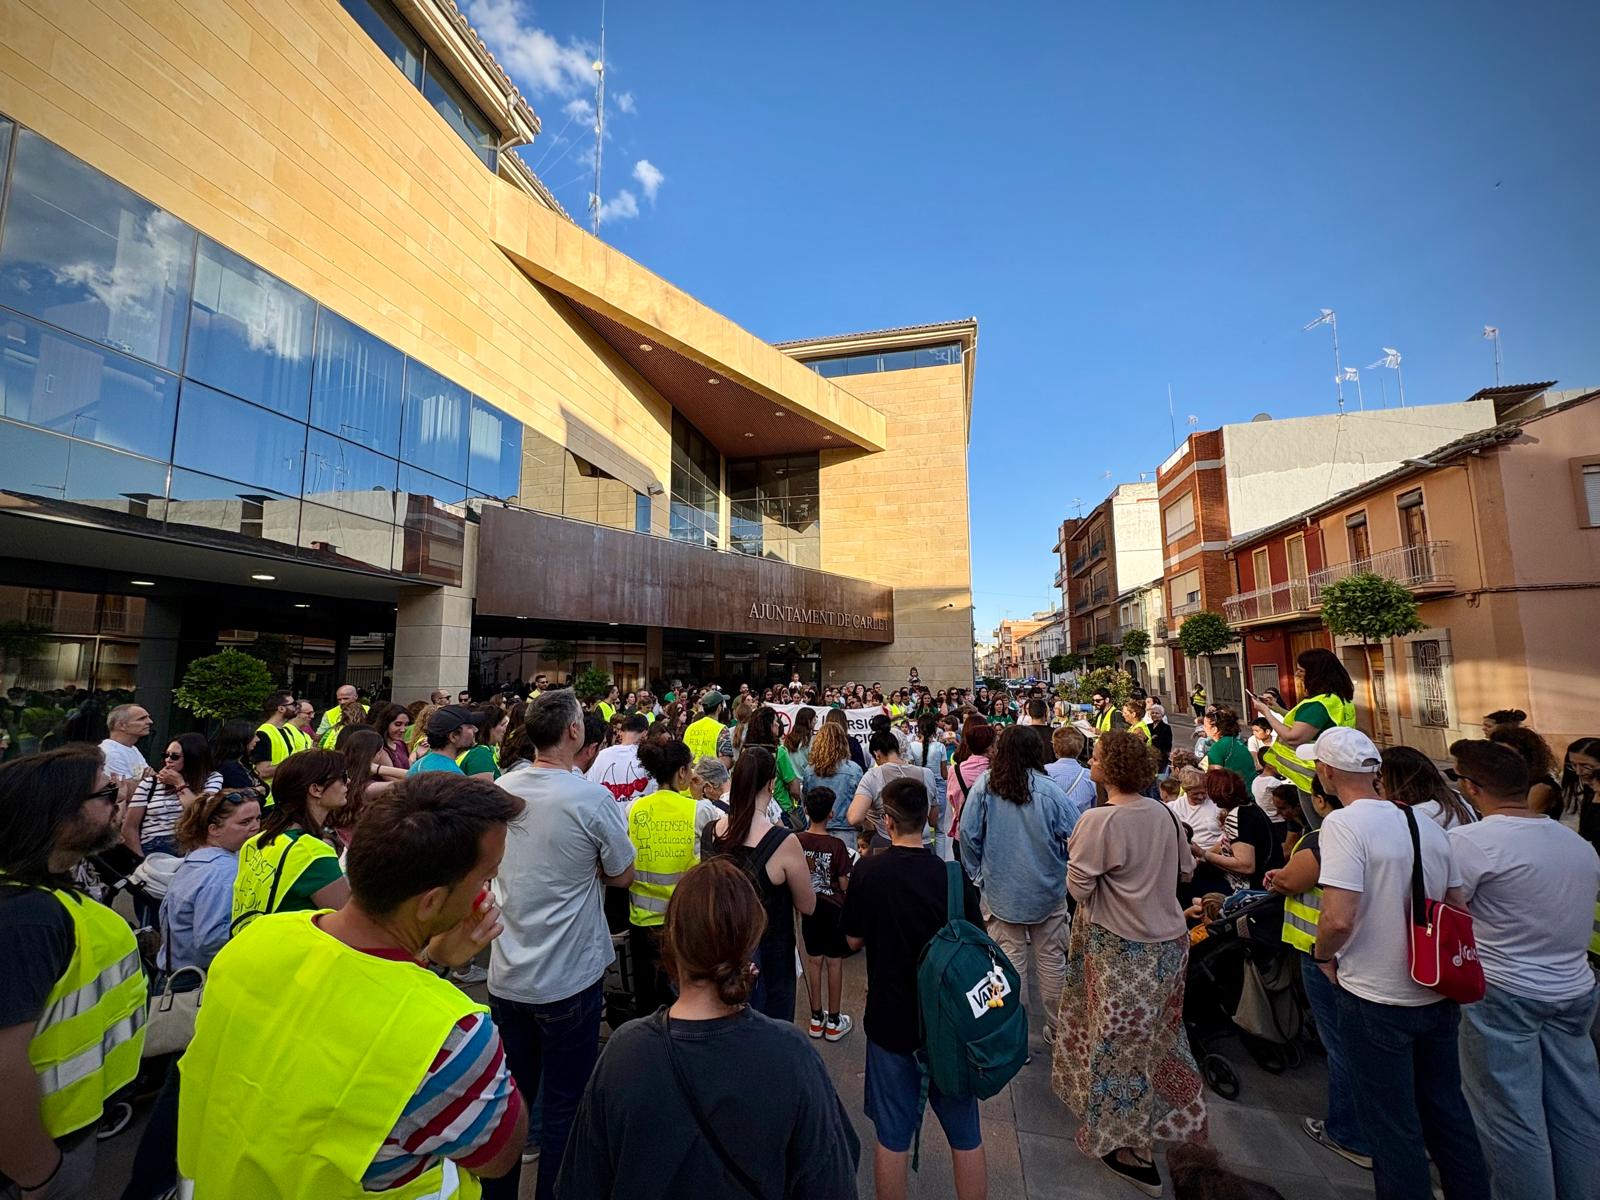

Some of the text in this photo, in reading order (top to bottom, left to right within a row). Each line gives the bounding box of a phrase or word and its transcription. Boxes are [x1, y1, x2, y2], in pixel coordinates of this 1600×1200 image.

[749, 603, 888, 631] AJUNTAMENT DE CARLET
[650, 820, 689, 832] DEFENSEM
